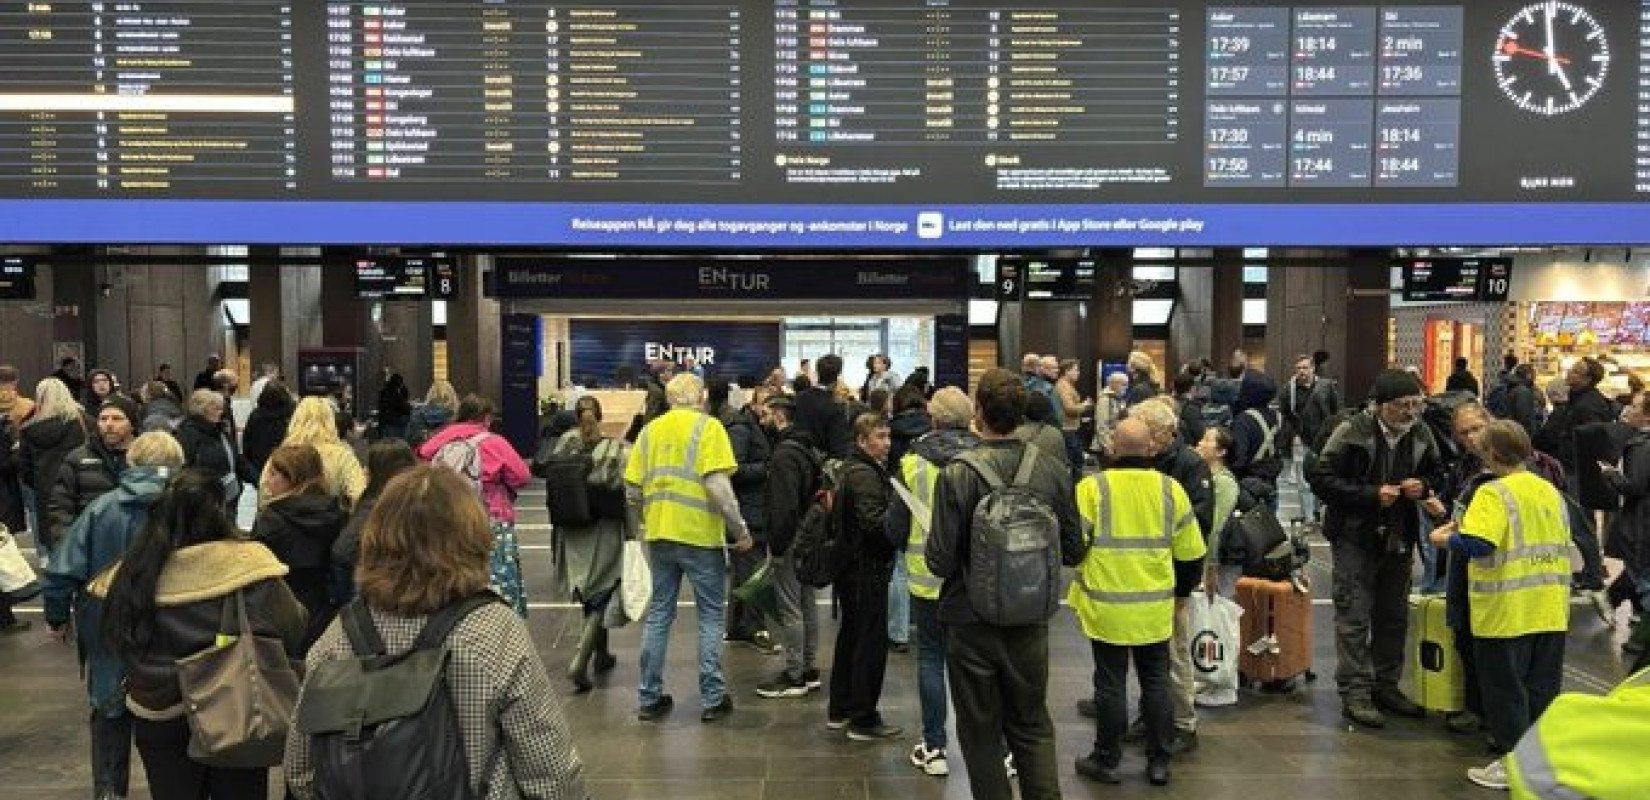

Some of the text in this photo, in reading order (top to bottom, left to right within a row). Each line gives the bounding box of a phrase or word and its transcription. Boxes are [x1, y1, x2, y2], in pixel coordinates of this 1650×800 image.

[1297, 36, 1336, 51] 18:14
[1396, 35, 1423, 51] min
[1297, 66, 1336, 81] 18:44
[1307, 127, 1333, 142] min
[637, 215, 655, 231] NÅ
[875, 219, 909, 234] Norge
[949, 218, 972, 232] Last
[973, 218, 996, 232] den
[997, 218, 1018, 232] ned
[1019, 218, 1050, 234] gratis
[1058, 219, 1081, 234] App
[1082, 218, 1111, 232] Store
[1113, 217, 1137, 232] eller
[1138, 217, 1179, 234] Google
[1180, 218, 1204, 234] play
[507, 270, 562, 284] Billetter
[699, 266, 770, 291] ENTUR
[857, 271, 908, 285] Billetter
[441, 278, 452, 294] 8
[1002, 278, 1015, 295] 9
[1489, 278, 1508, 295] 10
[644, 341, 715, 365] ENTUR
